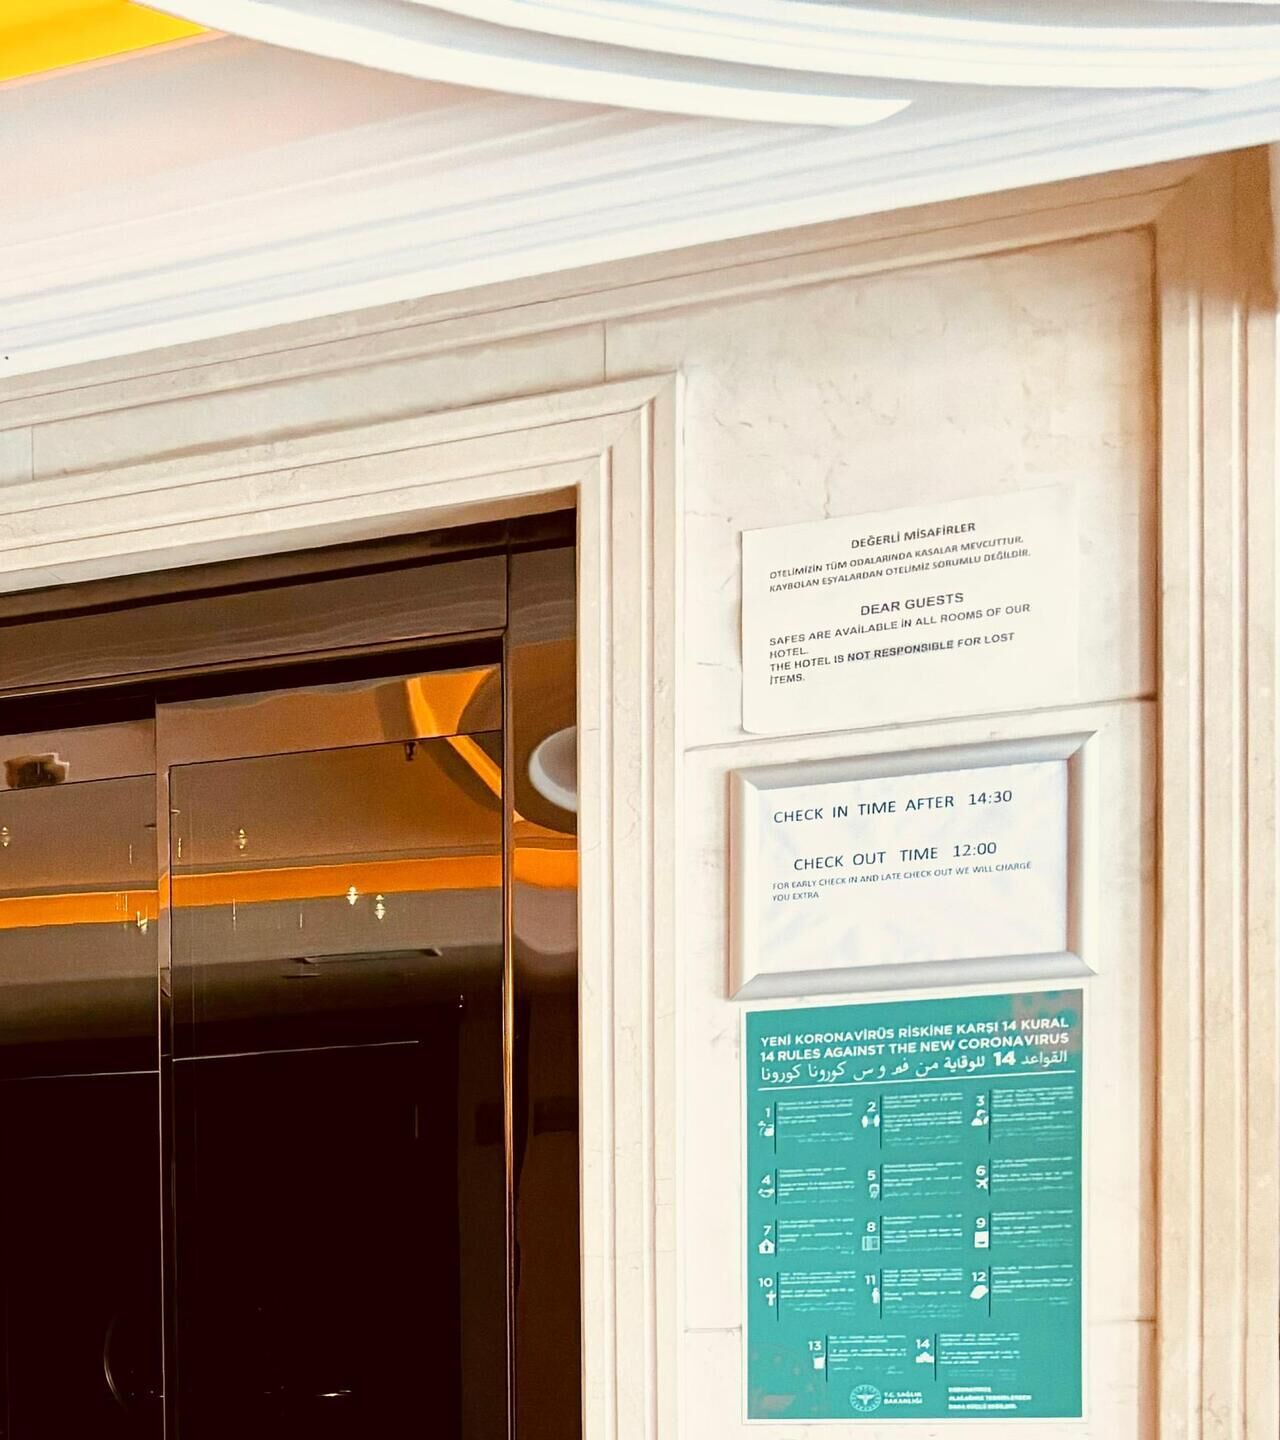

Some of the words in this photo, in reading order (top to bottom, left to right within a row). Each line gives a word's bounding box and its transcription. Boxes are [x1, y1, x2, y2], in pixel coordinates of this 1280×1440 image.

[851, 531, 900, 549] DEĞERLİ
[904, 522, 976, 541] MİSAFİRLER
[769, 564, 823, 580] OTELİMİZİN
[826, 560, 847, 571] TÜM
[850, 551, 913, 567] ODALARINDA
[915, 544, 958, 558] KASALAR
[769, 578, 820, 593] KAYBOLAN
[822, 569, 883, 586] EŞYALARDAN
[886, 562, 930, 576] OTELİMİZ
[932, 555, 981, 570] SORUMLU
[860, 601, 900, 616] DEAR
[905, 592, 965, 610] GUESTS
[769, 633, 806, 646] SAFES
[808, 630, 832, 640] ARE
[915, 616, 937, 627] ALL
[940, 609, 983, 623] ROOMS
[986, 607, 1002, 617] OF
[1005, 603, 1031, 615] OUR
[769, 647, 809, 659] HOTEL.
[770, 661, 792, 672] THE
[794, 656, 831, 669] HOTEL
[834, 654, 845, 664] IS
[847, 651, 871, 662] NOT
[874, 640, 955, 659] RESPONSIBLE
[957, 636, 981, 648] FOR
[984, 632, 1016, 644] LOST
[773, 807, 824, 823] CHECK
[832, 805, 848, 818] IN
[858, 801, 896, 816] TIME
[905, 795, 954, 812] AFTER
[968, 790, 1013, 806] 14:30
[793, 855, 844, 871] CHECK
[852, 851, 886, 866] OUT
[899, 847, 938, 862] TIME
[952, 841, 997, 857] 12:00
[772, 881, 790, 890] FOR
[791, 879, 817, 889] EARLY
[818, 877, 846, 887] CHECK
[848, 875, 858, 884] IN
[860, 873, 879, 883] AND
[880, 871, 901, 881] LATE
[903, 869, 932, 879] CHECK
[934, 867, 953, 877] OUT
[955, 866, 970, 875] WE
[972, 864, 993, 874] WILL
[995, 861, 1032, 872] CHARGE
[772, 892, 790, 902] YOU
[792, 889, 819, 900] EXTRA
[760, 1033, 791, 1047] YENİ
[795, 1027, 894, 1045] KORONAVİRÜS
[899, 1023, 952, 1038] RİSKİNE
[956, 1021, 998, 1035] KARŞI
[1002, 1020, 1016, 1031] 14
[1021, 1017, 1069, 1030] KURAL
[760, 1052, 774, 1062] 14
[778, 1048, 820, 1061] RULES
[824, 1044, 884, 1058] AGAINST
[888, 1041, 916, 1054] THE
[920, 1041, 955, 1053] NEW
[958, 1033, 1069, 1049] CORONAVIRUS
[944, 1056, 985, 1073] للوقاية
[993, 1051, 1016, 1066] 14
[1021, 1050, 1067, 1067] القواعد
[761, 1064, 801, 1083] كورونا
[808, 1061, 847, 1083] كورونا
[915, 1062, 939, 1077] من
[867, 1101, 876, 1113] 2
[976, 1095, 985, 1106] 3
[765, 1107, 771, 1118] 1
[867, 1170, 876, 1181] 5
[975, 1165, 986, 1176] 6
[761, 1174, 771, 1185] 4
[763, 1225, 772, 1235] 7
[867, 1222, 876, 1232] 8
[976, 1218, 986, 1228] 9
[758, 1277, 773, 1287] 10
[865, 1274, 876, 1285] 11
[972, 1271, 986, 1282] 12
[808, 1341, 821, 1351] 13
[916, 1339, 930, 1349] 14
